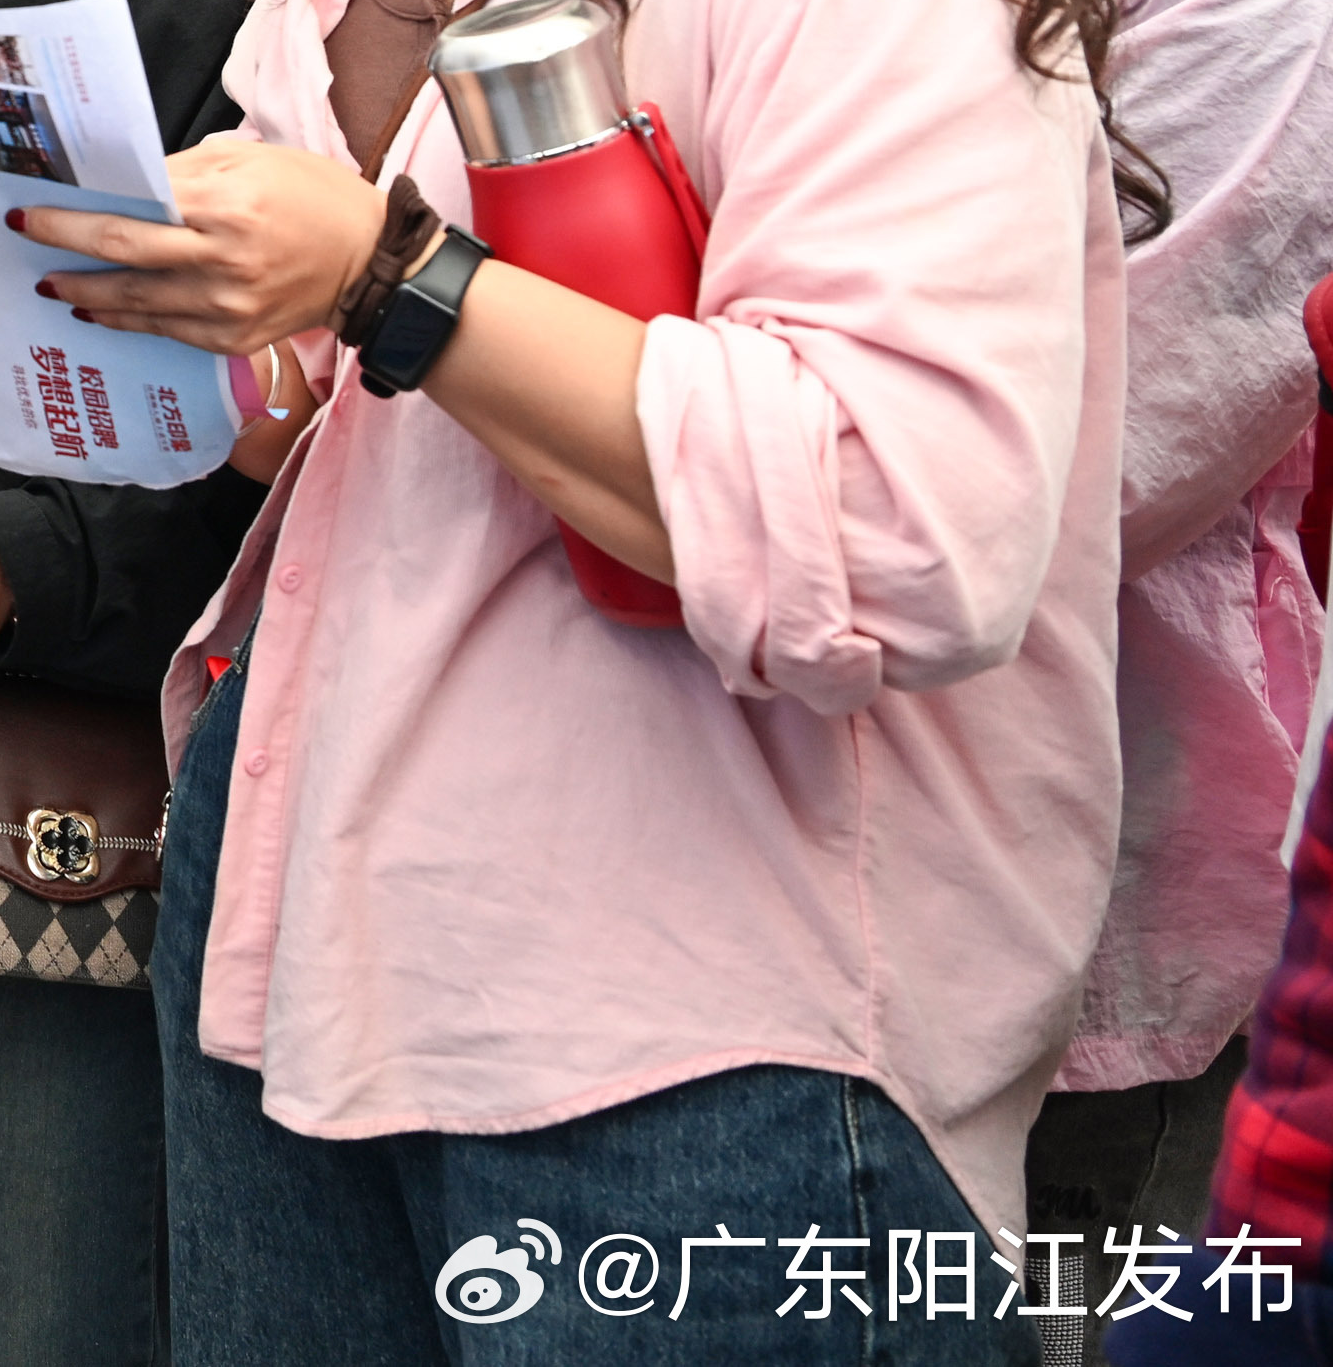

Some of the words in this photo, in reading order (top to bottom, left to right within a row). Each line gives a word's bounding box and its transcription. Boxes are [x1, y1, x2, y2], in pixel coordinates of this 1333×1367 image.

[29, 344, 91, 462] 梦想起航
[76, 363, 121, 450] 校园招聘
